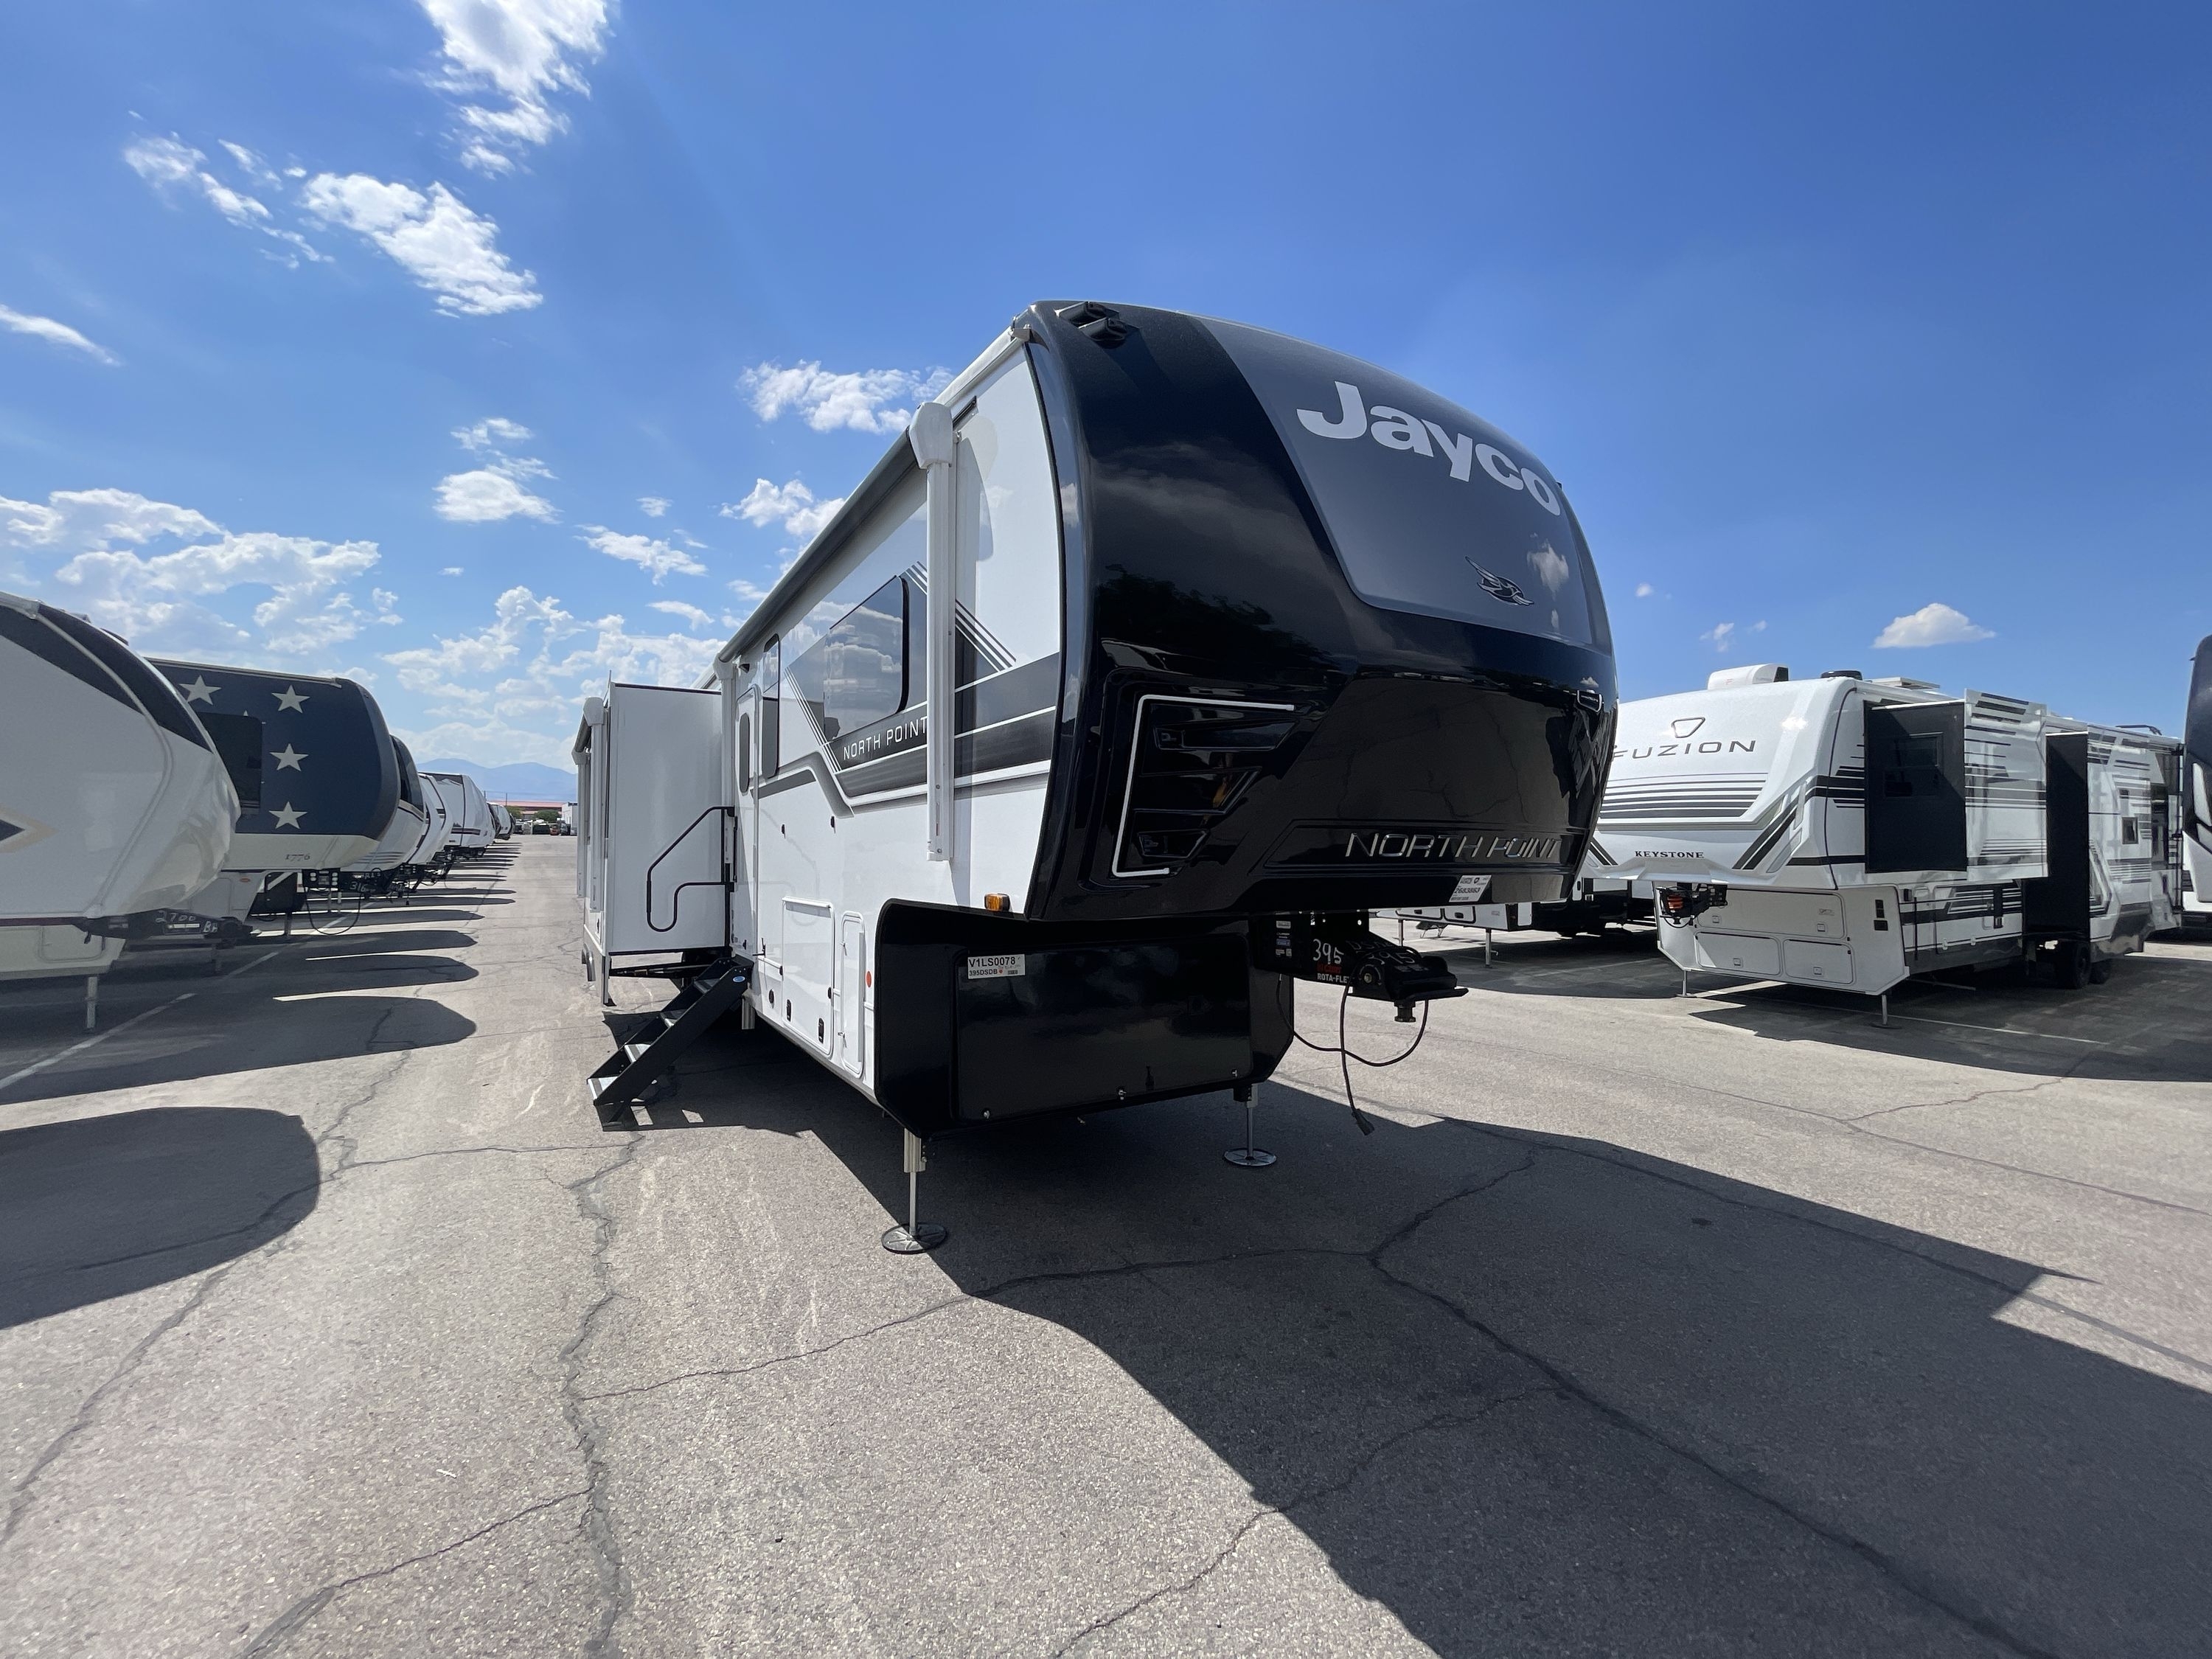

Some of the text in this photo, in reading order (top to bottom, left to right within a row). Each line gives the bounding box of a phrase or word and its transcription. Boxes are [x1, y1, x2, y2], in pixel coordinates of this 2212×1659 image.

[1296, 380, 1561, 516] Jayco
[844, 715, 928, 761] NORTH POINT
[1612, 740, 1756, 762] FUZION
[1345, 832, 1562, 858] NORTH POINT
[1634, 850, 1705, 859] KEYSTONE
[968, 956, 1016, 967] V1LS0078
[1312, 938, 1345, 965] 395
[969, 968, 998, 976] 395DSDB
[1317, 973, 1354, 984] ROTA-FLE
